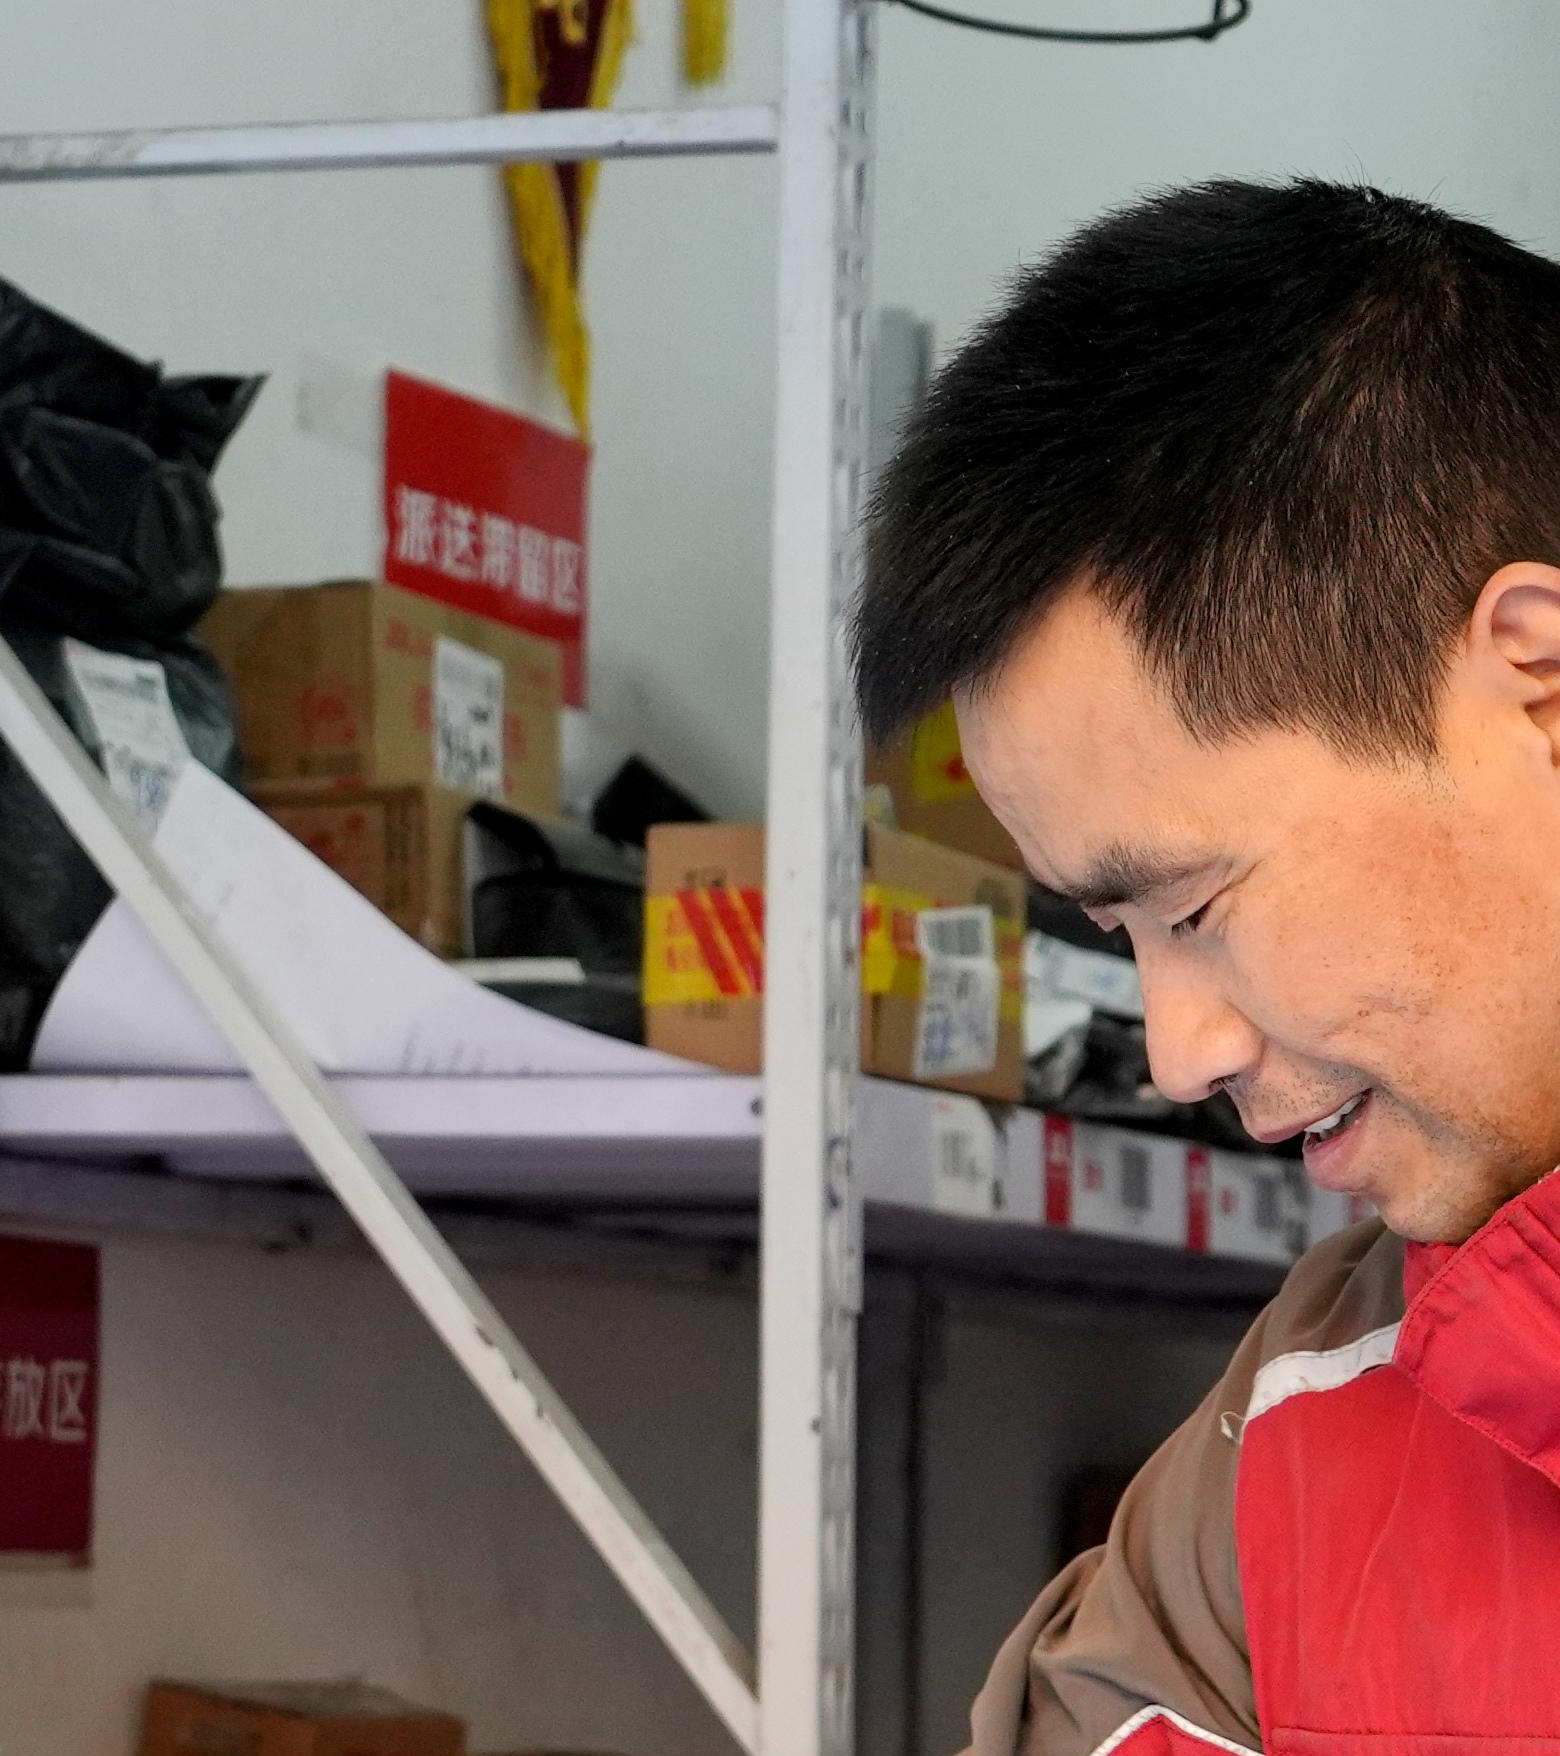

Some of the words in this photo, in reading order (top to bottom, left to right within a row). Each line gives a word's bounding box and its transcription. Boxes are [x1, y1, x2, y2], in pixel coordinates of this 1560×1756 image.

[395, 484, 587, 614] 派送滞留区
